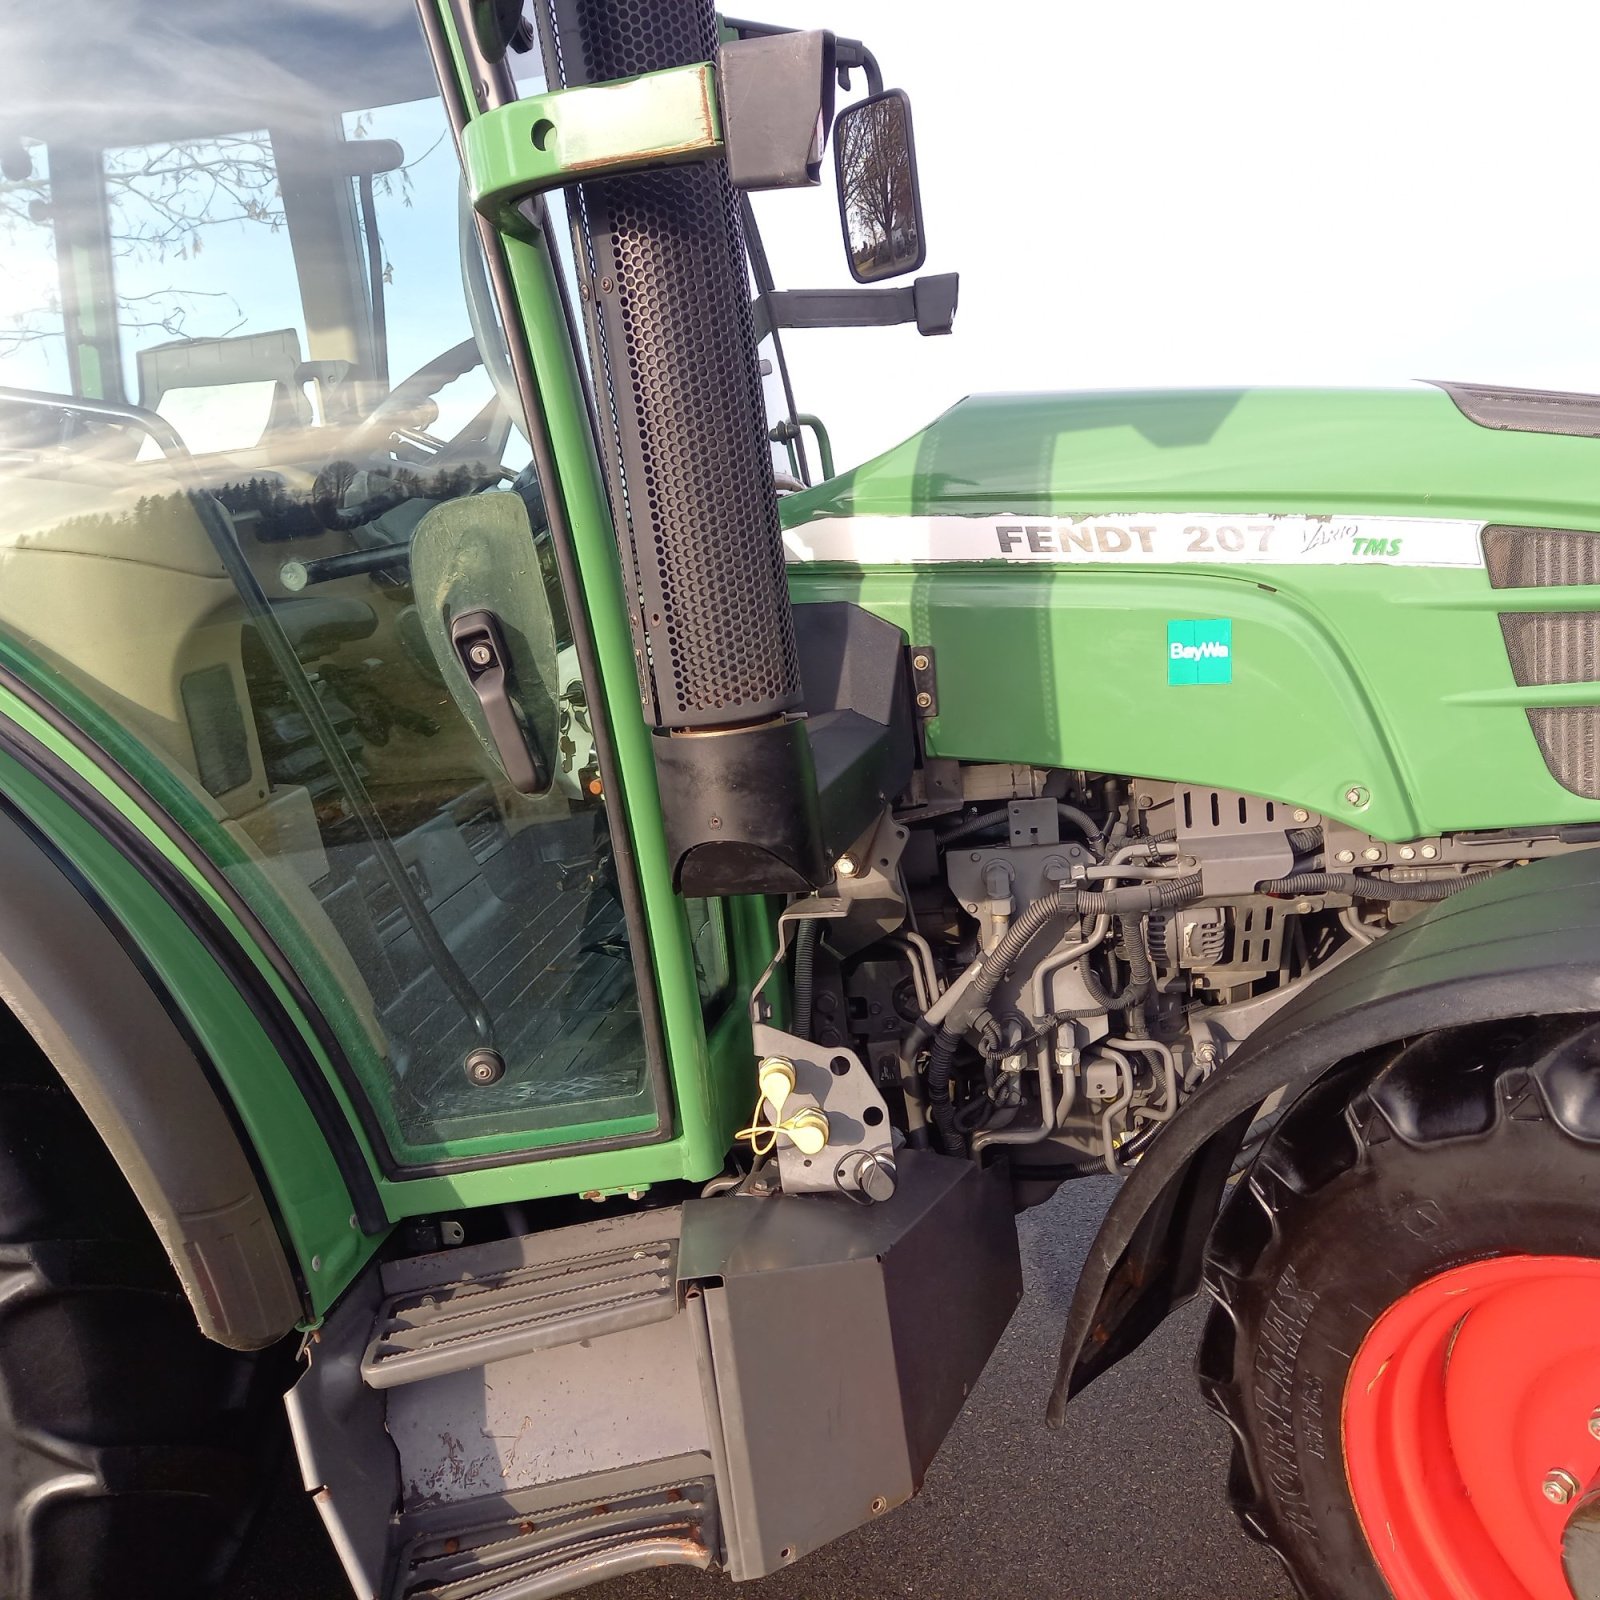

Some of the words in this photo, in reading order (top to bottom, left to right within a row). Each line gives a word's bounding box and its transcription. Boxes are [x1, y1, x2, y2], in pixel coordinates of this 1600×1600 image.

[996, 526, 1157, 553] FENDT
[1182, 526, 1275, 553] 207
[1351, 537, 1404, 556] TMS
[1170, 641, 1229, 662] BayWa
